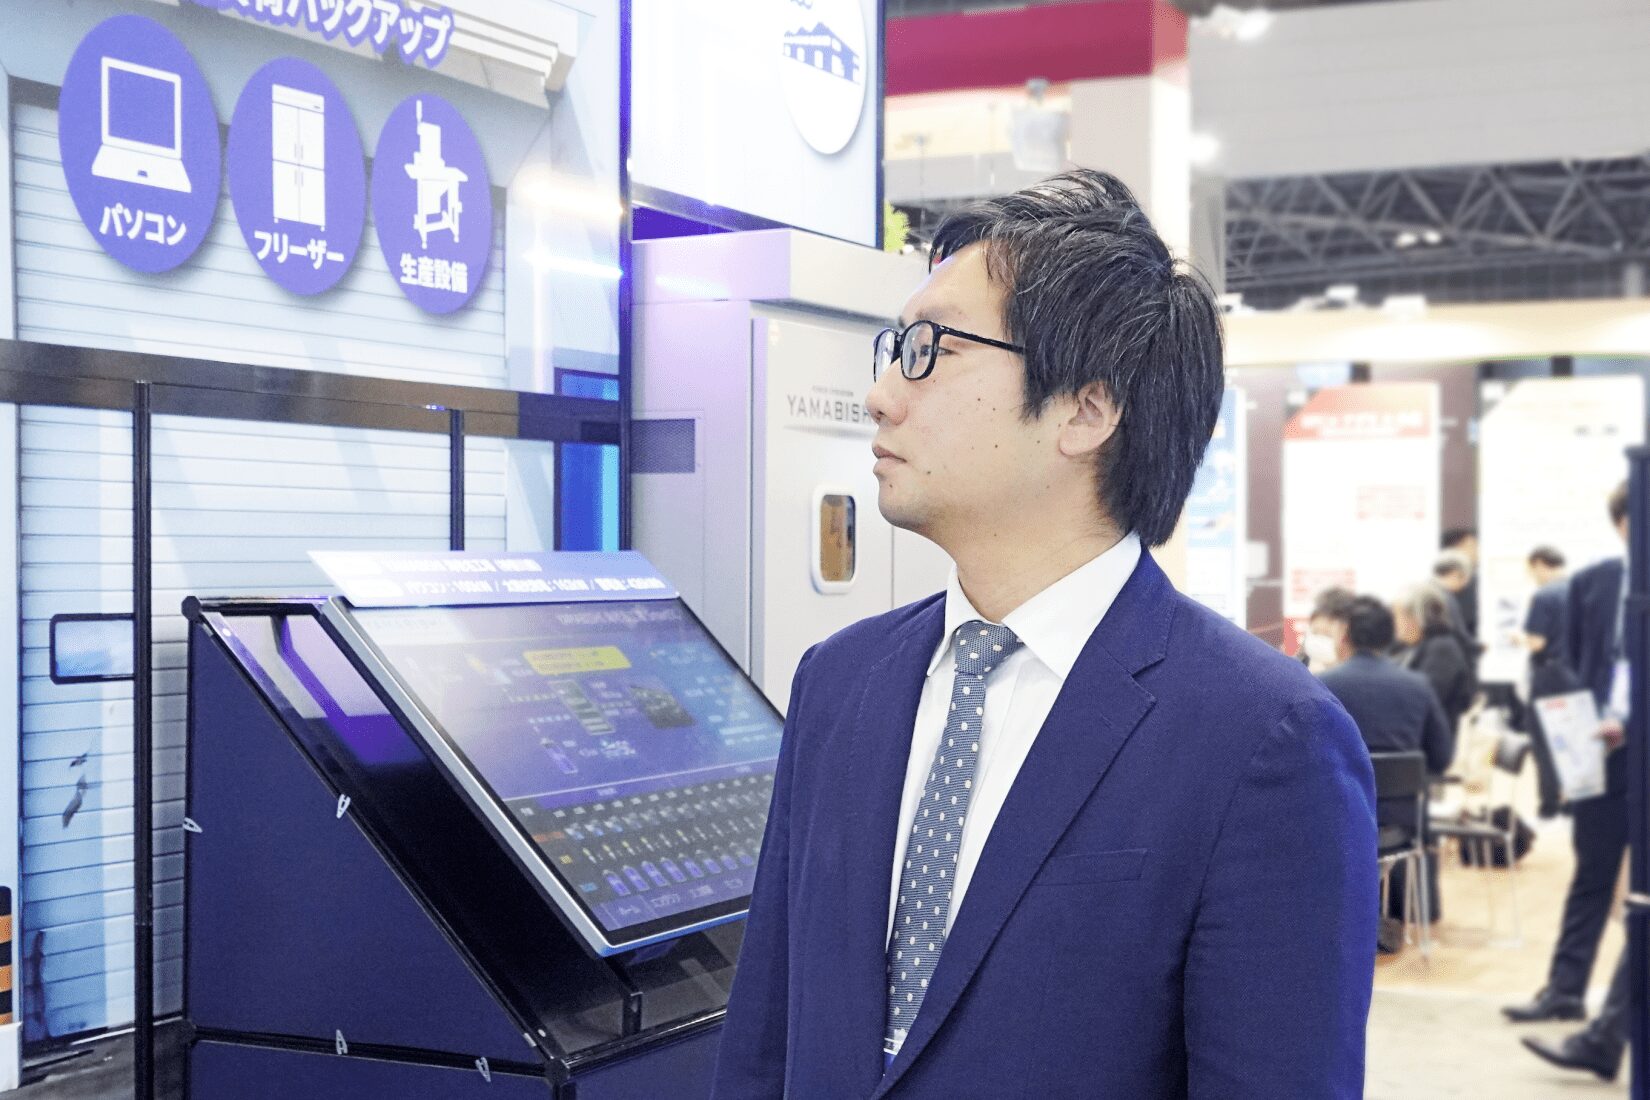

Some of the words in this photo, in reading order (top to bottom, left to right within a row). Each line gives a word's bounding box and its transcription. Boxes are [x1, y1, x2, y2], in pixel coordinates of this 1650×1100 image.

[99, 203, 187, 246] パソコン
[254, 230, 345, 270] フリーザー
[400, 253, 467, 294] 生産設備
